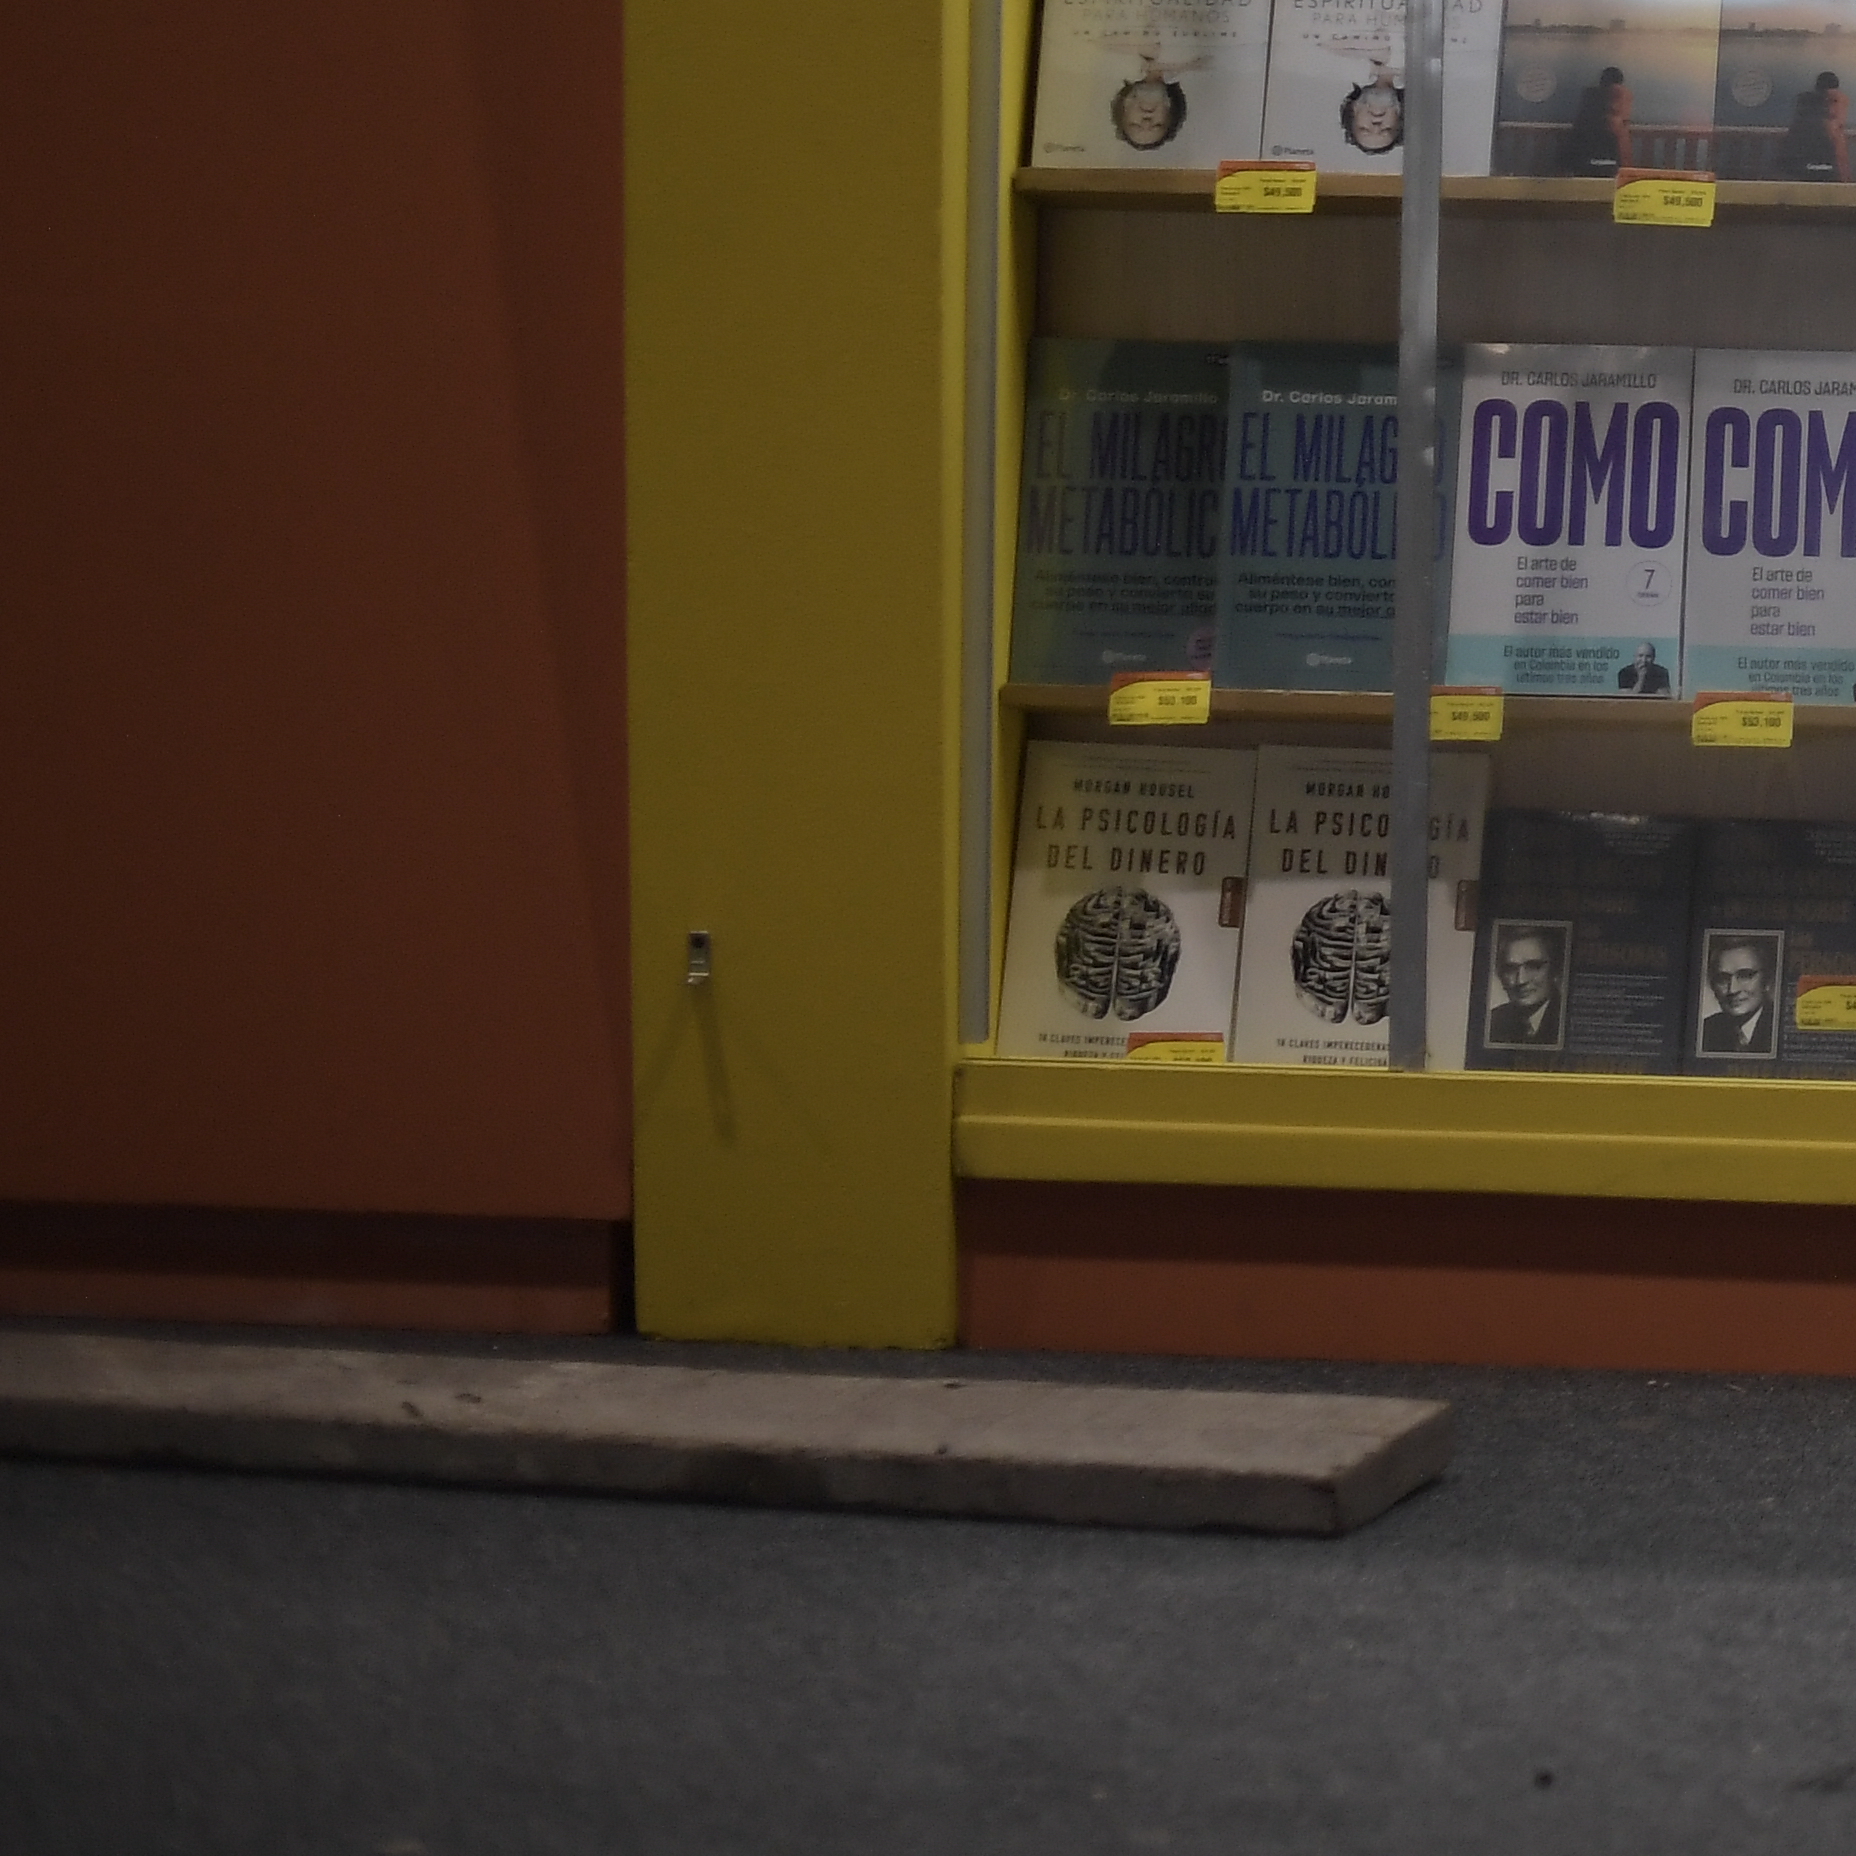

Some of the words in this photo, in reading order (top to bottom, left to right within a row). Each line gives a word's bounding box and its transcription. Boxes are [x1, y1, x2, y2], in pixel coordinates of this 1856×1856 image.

[1501, 371, 1523, 387] DR.
[1527, 371, 1578, 387] CARLOS
[1581, 372, 1657, 389] JARAMILLO
[1468, 398, 1680, 549] COMO
[1518, 556, 1528, 571] El
[1531, 557, 1557, 571] arte
[1561, 557, 1576, 571] de
[1516, 575, 1557, 589] comer
[1561, 575, 1588, 589] bien
[1514, 610, 1548, 624] estar
[1551, 610, 1579, 624] bien
[1037, 806, 1065, 830] LA
[1082, 807, 1236, 840] PSICOLOGÍA
[1047, 845, 1093, 870] DEL
[1110, 847, 1206, 876] DINERO
